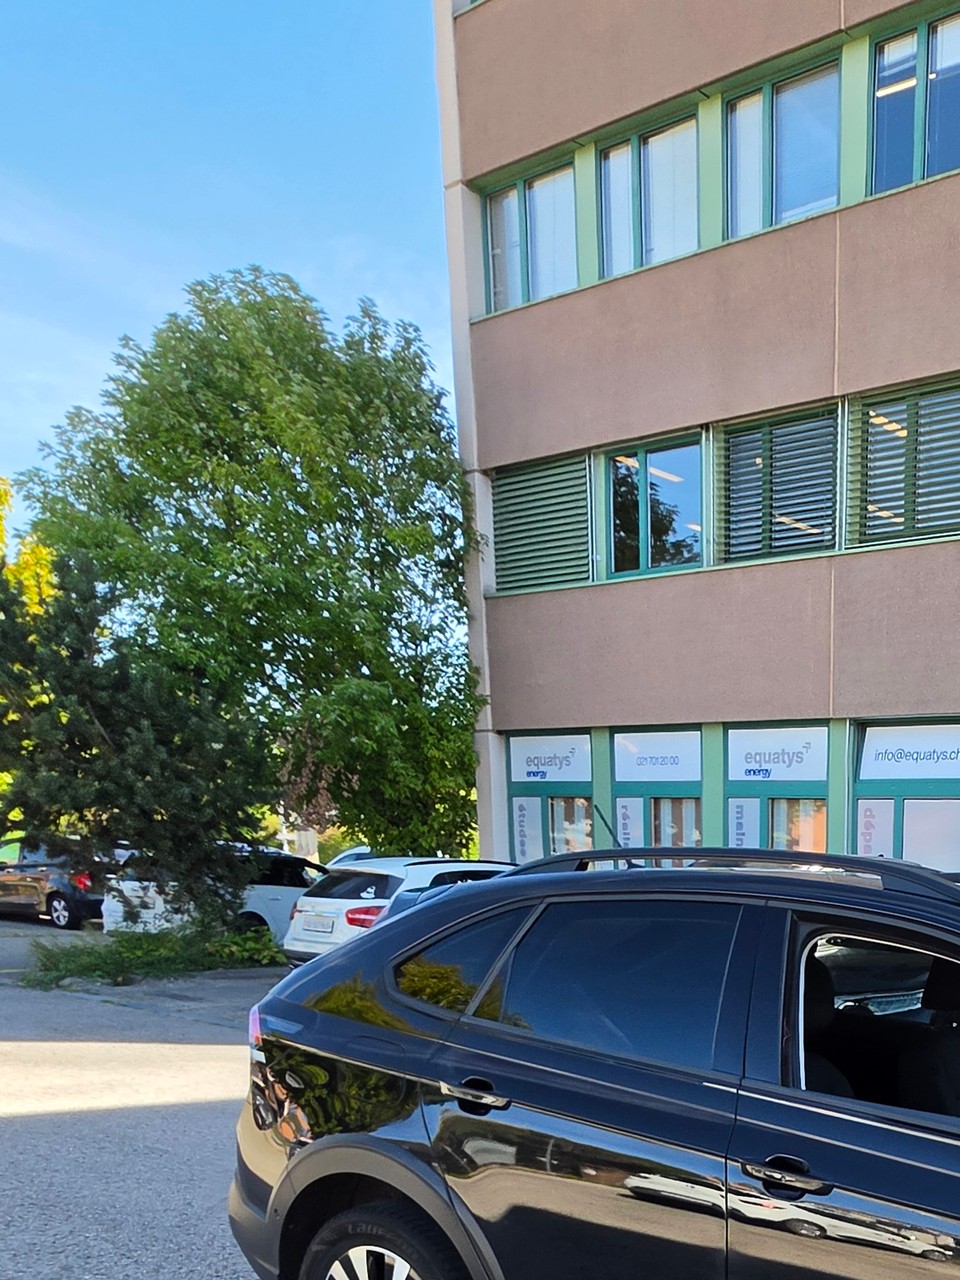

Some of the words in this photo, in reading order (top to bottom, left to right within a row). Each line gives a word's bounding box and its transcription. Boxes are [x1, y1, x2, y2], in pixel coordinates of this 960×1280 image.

[525, 753, 572, 770] equatys
[744, 748, 805, 769] equatys
[526, 770, 548, 779] energy
[744, 768, 772, 779] energy
